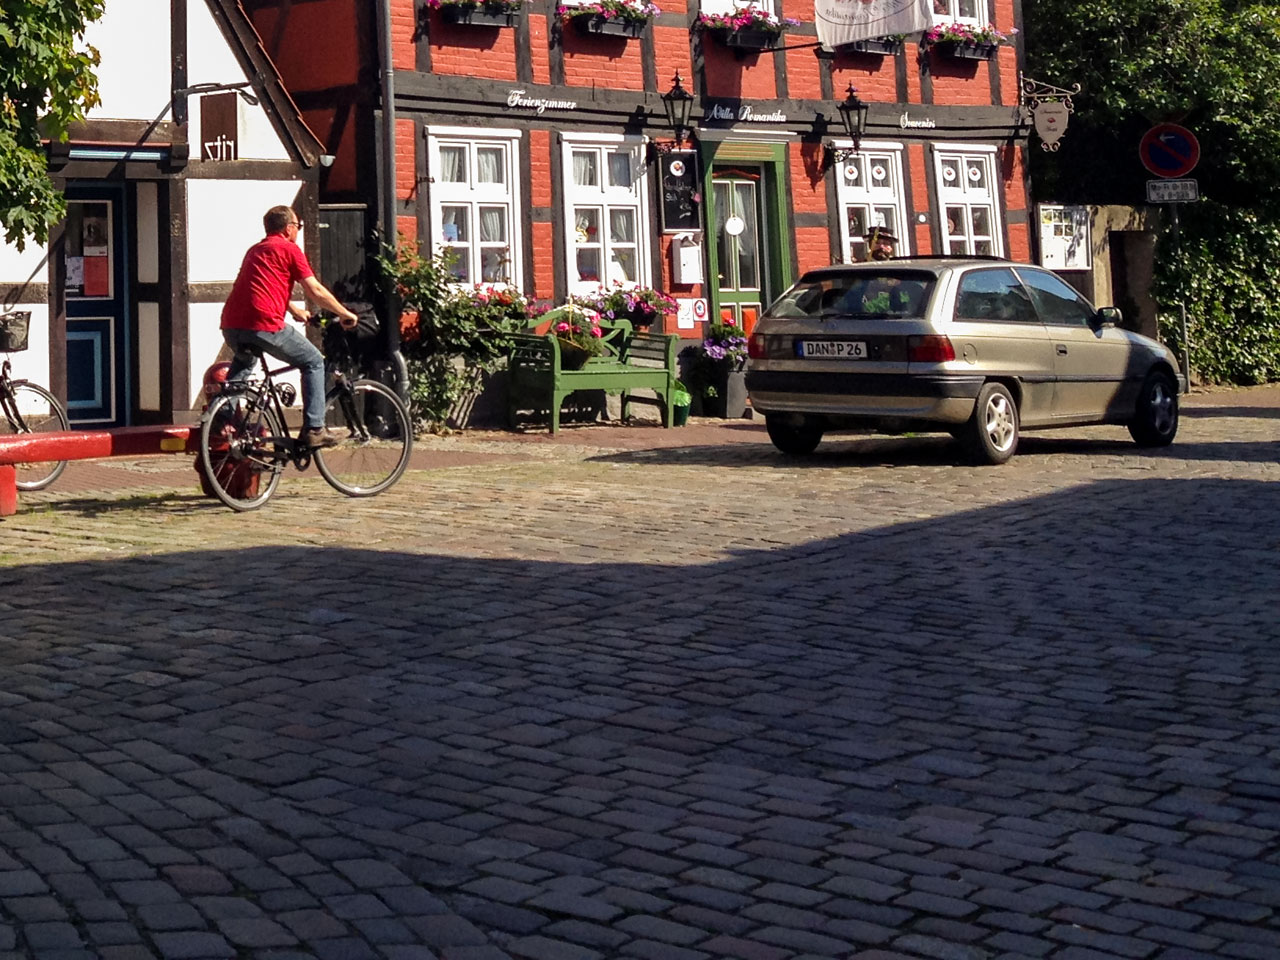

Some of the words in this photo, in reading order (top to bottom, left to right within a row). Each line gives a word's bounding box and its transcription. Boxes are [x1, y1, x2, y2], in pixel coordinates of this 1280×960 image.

[508, 90, 577, 114] Ferienzimmer
[738, 105, 787, 122] Romantika
[807, 343, 829, 355] DAN
[837, 343, 844, 355] P
[847, 343, 862, 356] 26
